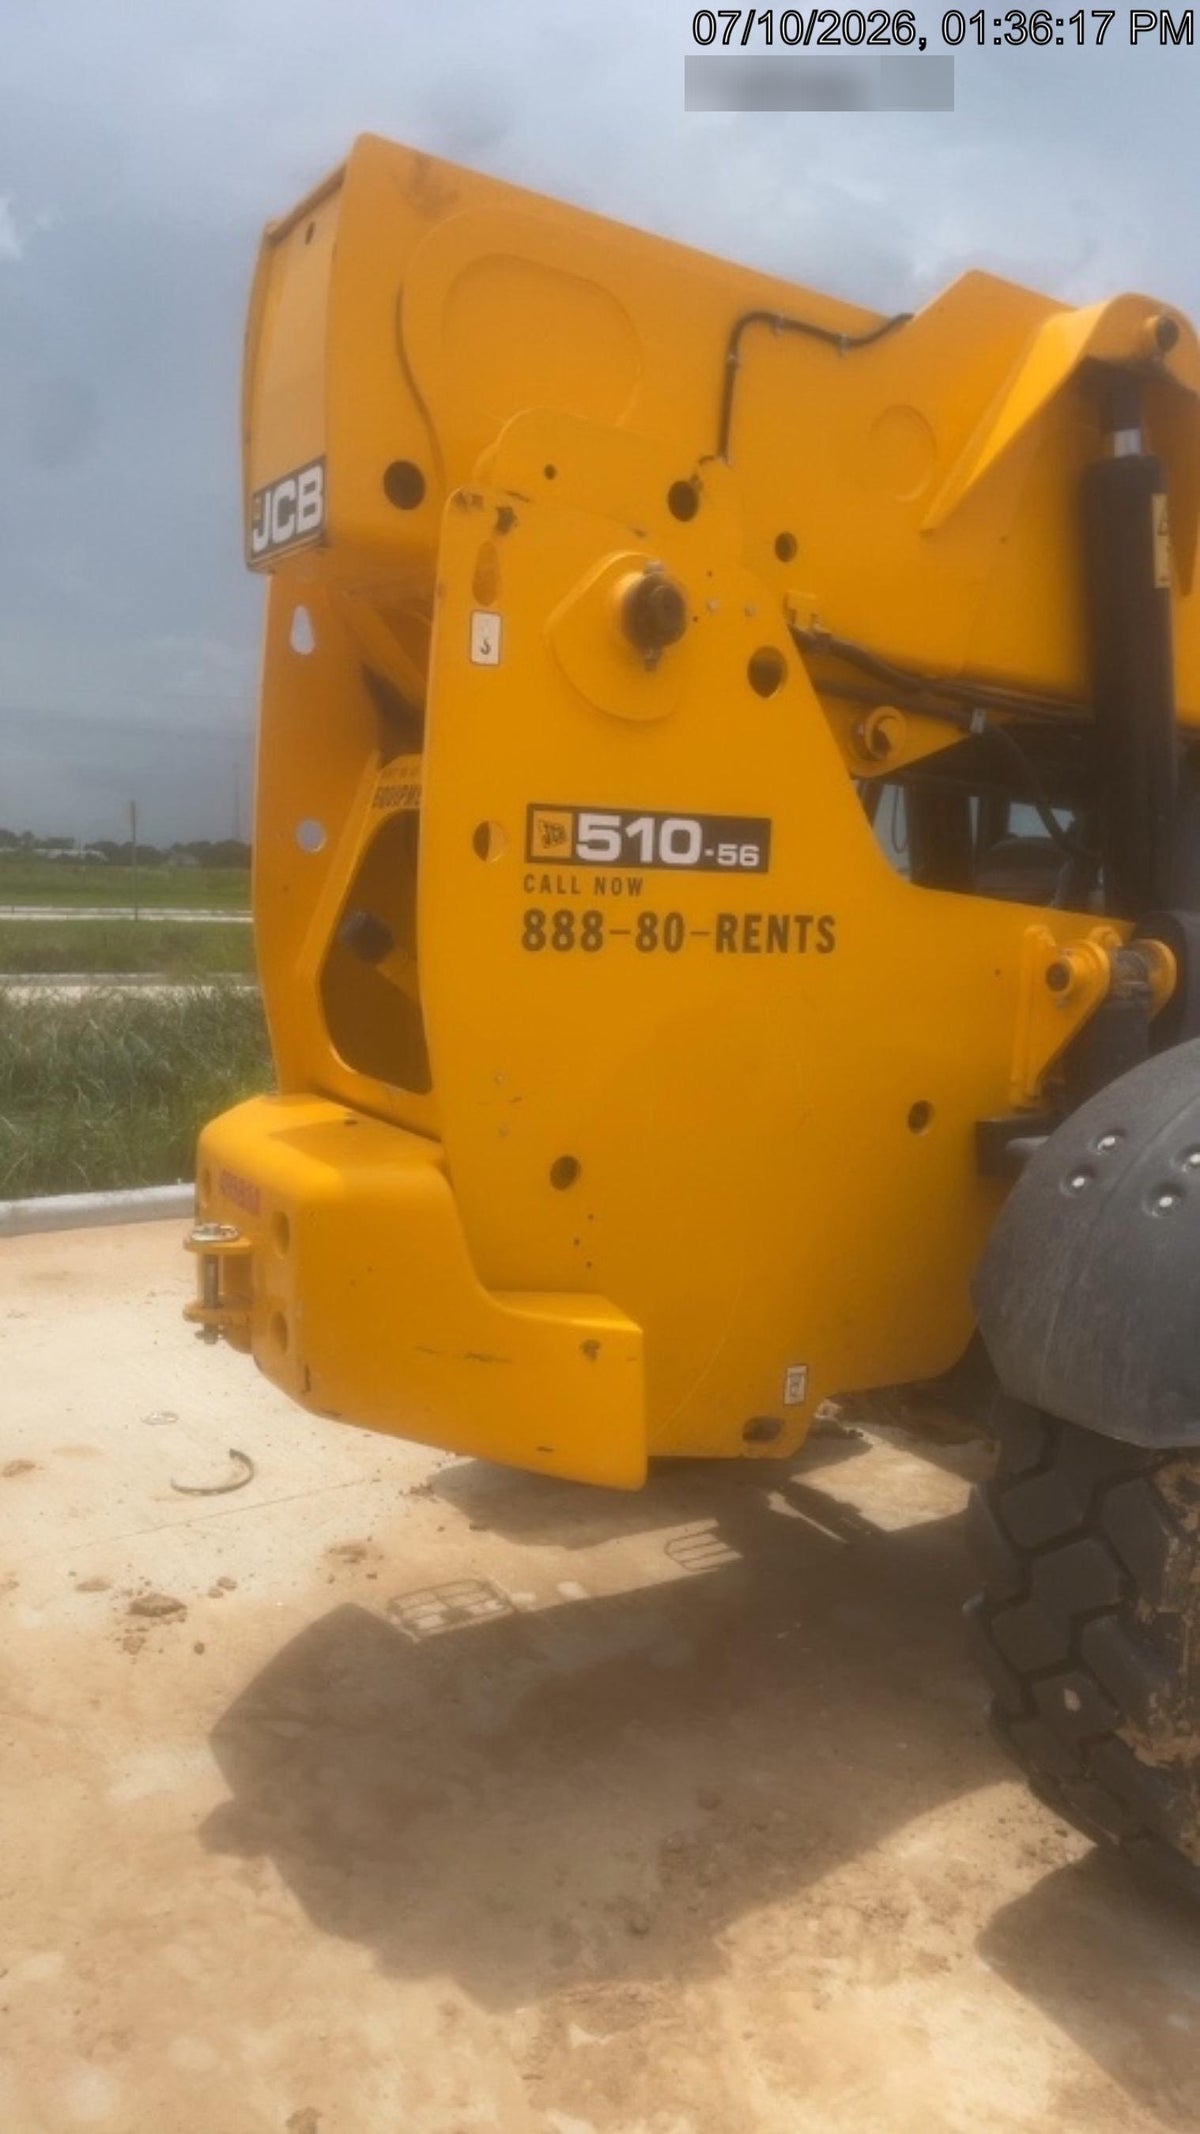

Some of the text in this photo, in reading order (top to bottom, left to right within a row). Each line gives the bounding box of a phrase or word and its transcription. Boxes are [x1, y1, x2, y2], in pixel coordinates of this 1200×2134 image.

[252, 465, 323, 553] JCB
[576, 813, 760, 866] 510-56
[523, 873, 643, 896] CALL NOW
[522, 908, 836, 953] 888-80-RENTS
